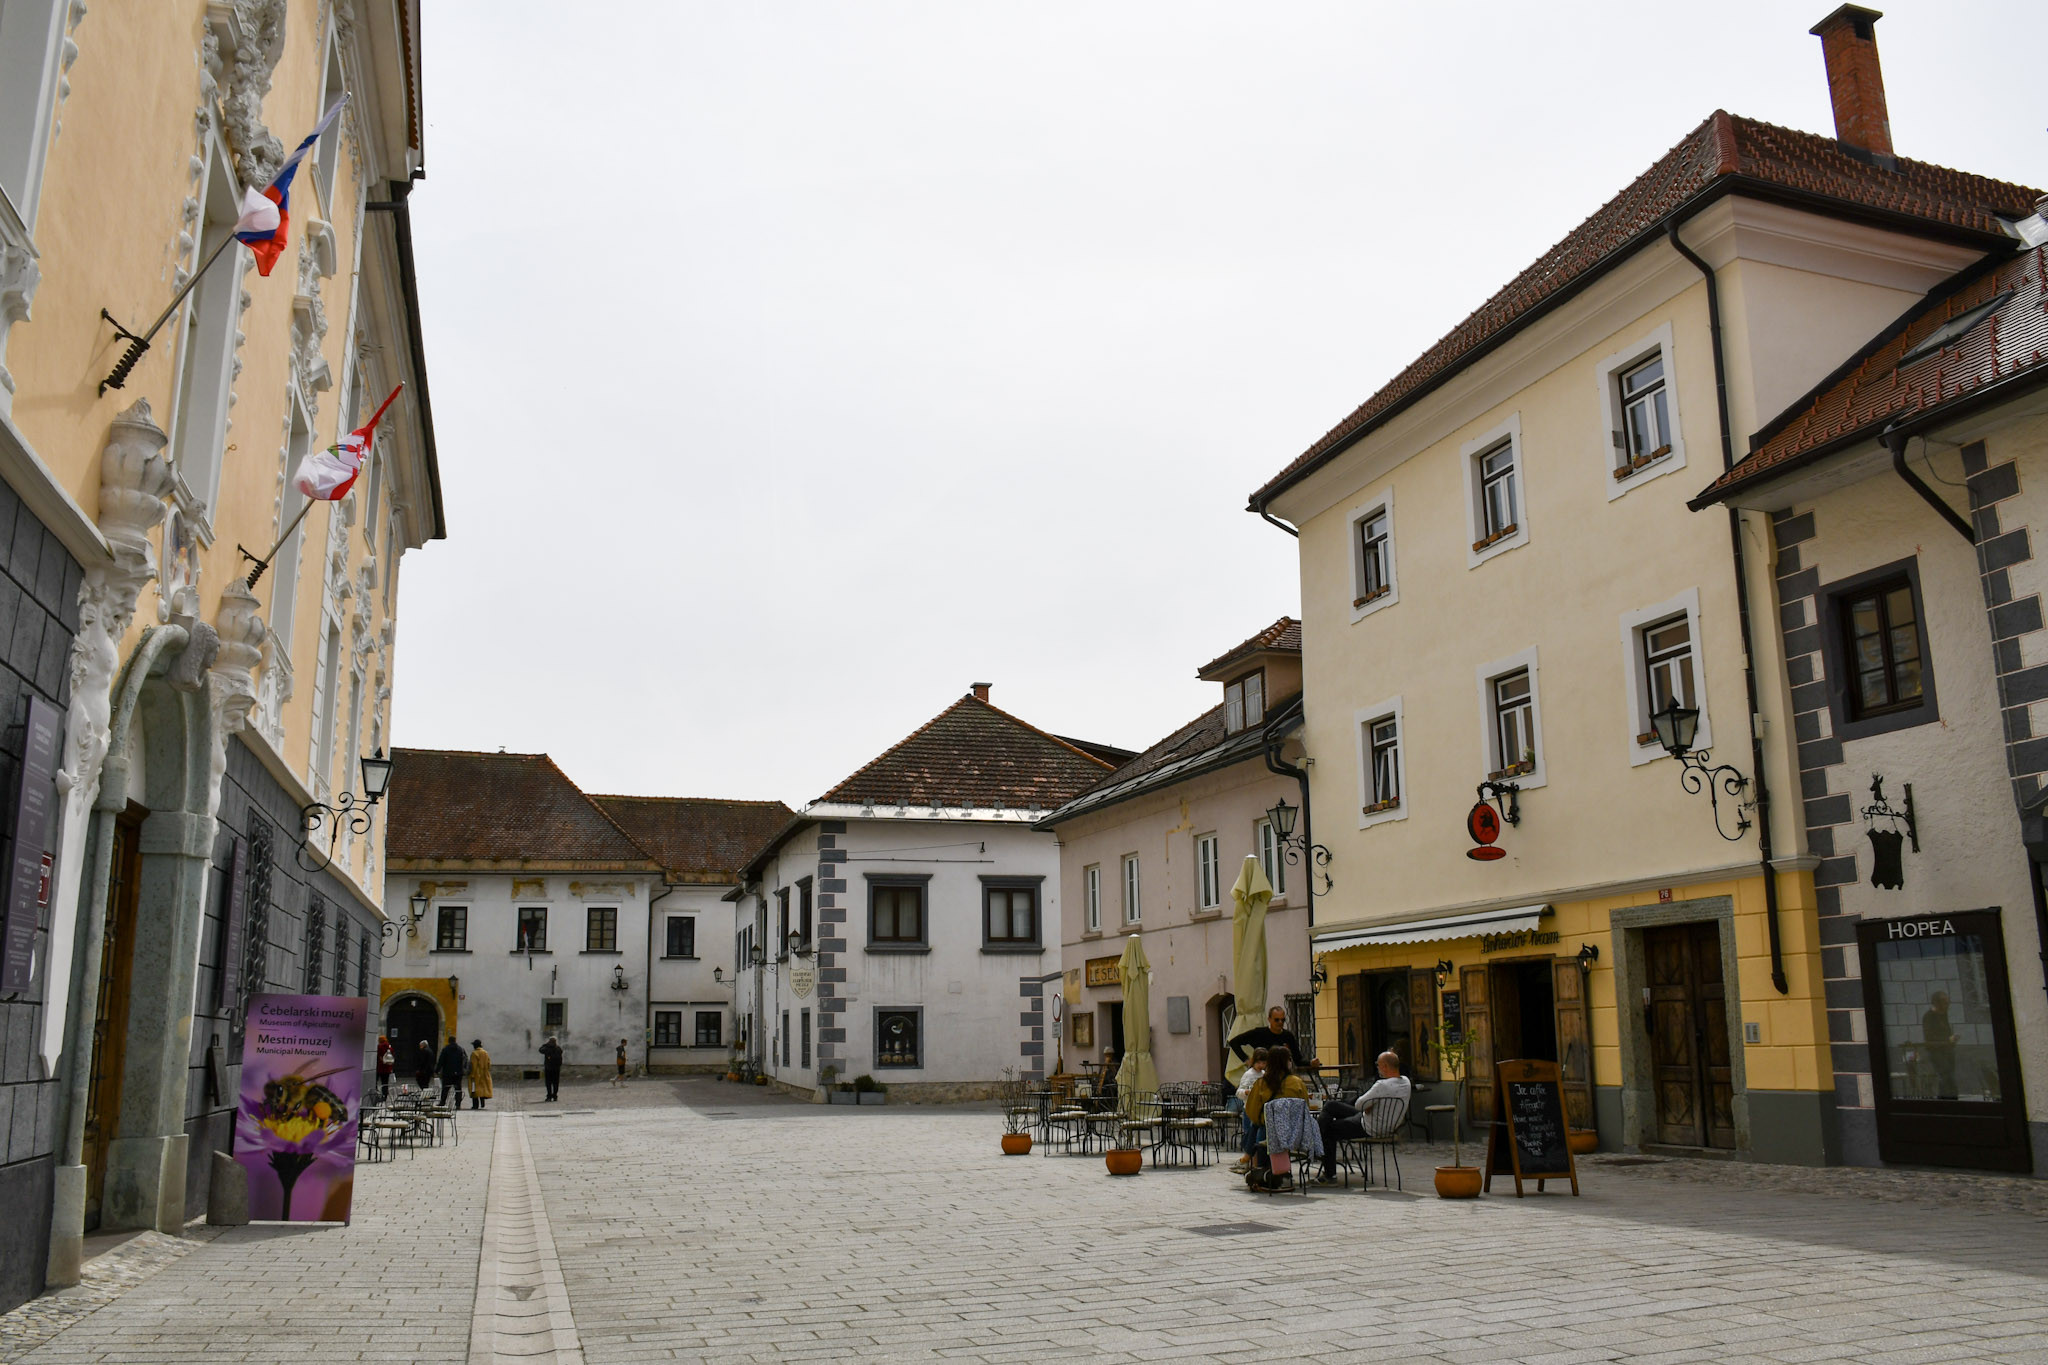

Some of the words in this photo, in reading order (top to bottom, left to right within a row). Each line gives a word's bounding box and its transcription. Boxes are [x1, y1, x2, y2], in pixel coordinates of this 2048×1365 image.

[1887, 920, 1956, 939] HOPEA
[260, 1003, 319, 1018] Čebelarski
[321, 1008, 355, 1021] muzej
[259, 1019, 292, 1027] Museum
[293, 1019, 301, 1027] of
[302, 1020, 341, 1029] Apiculture
[257, 1034, 297, 1044] Mestni
[298, 1036, 332, 1049] muzej
[256, 1047, 293, 1056] Municipal
[294, 1048, 327, 1056] Museum
